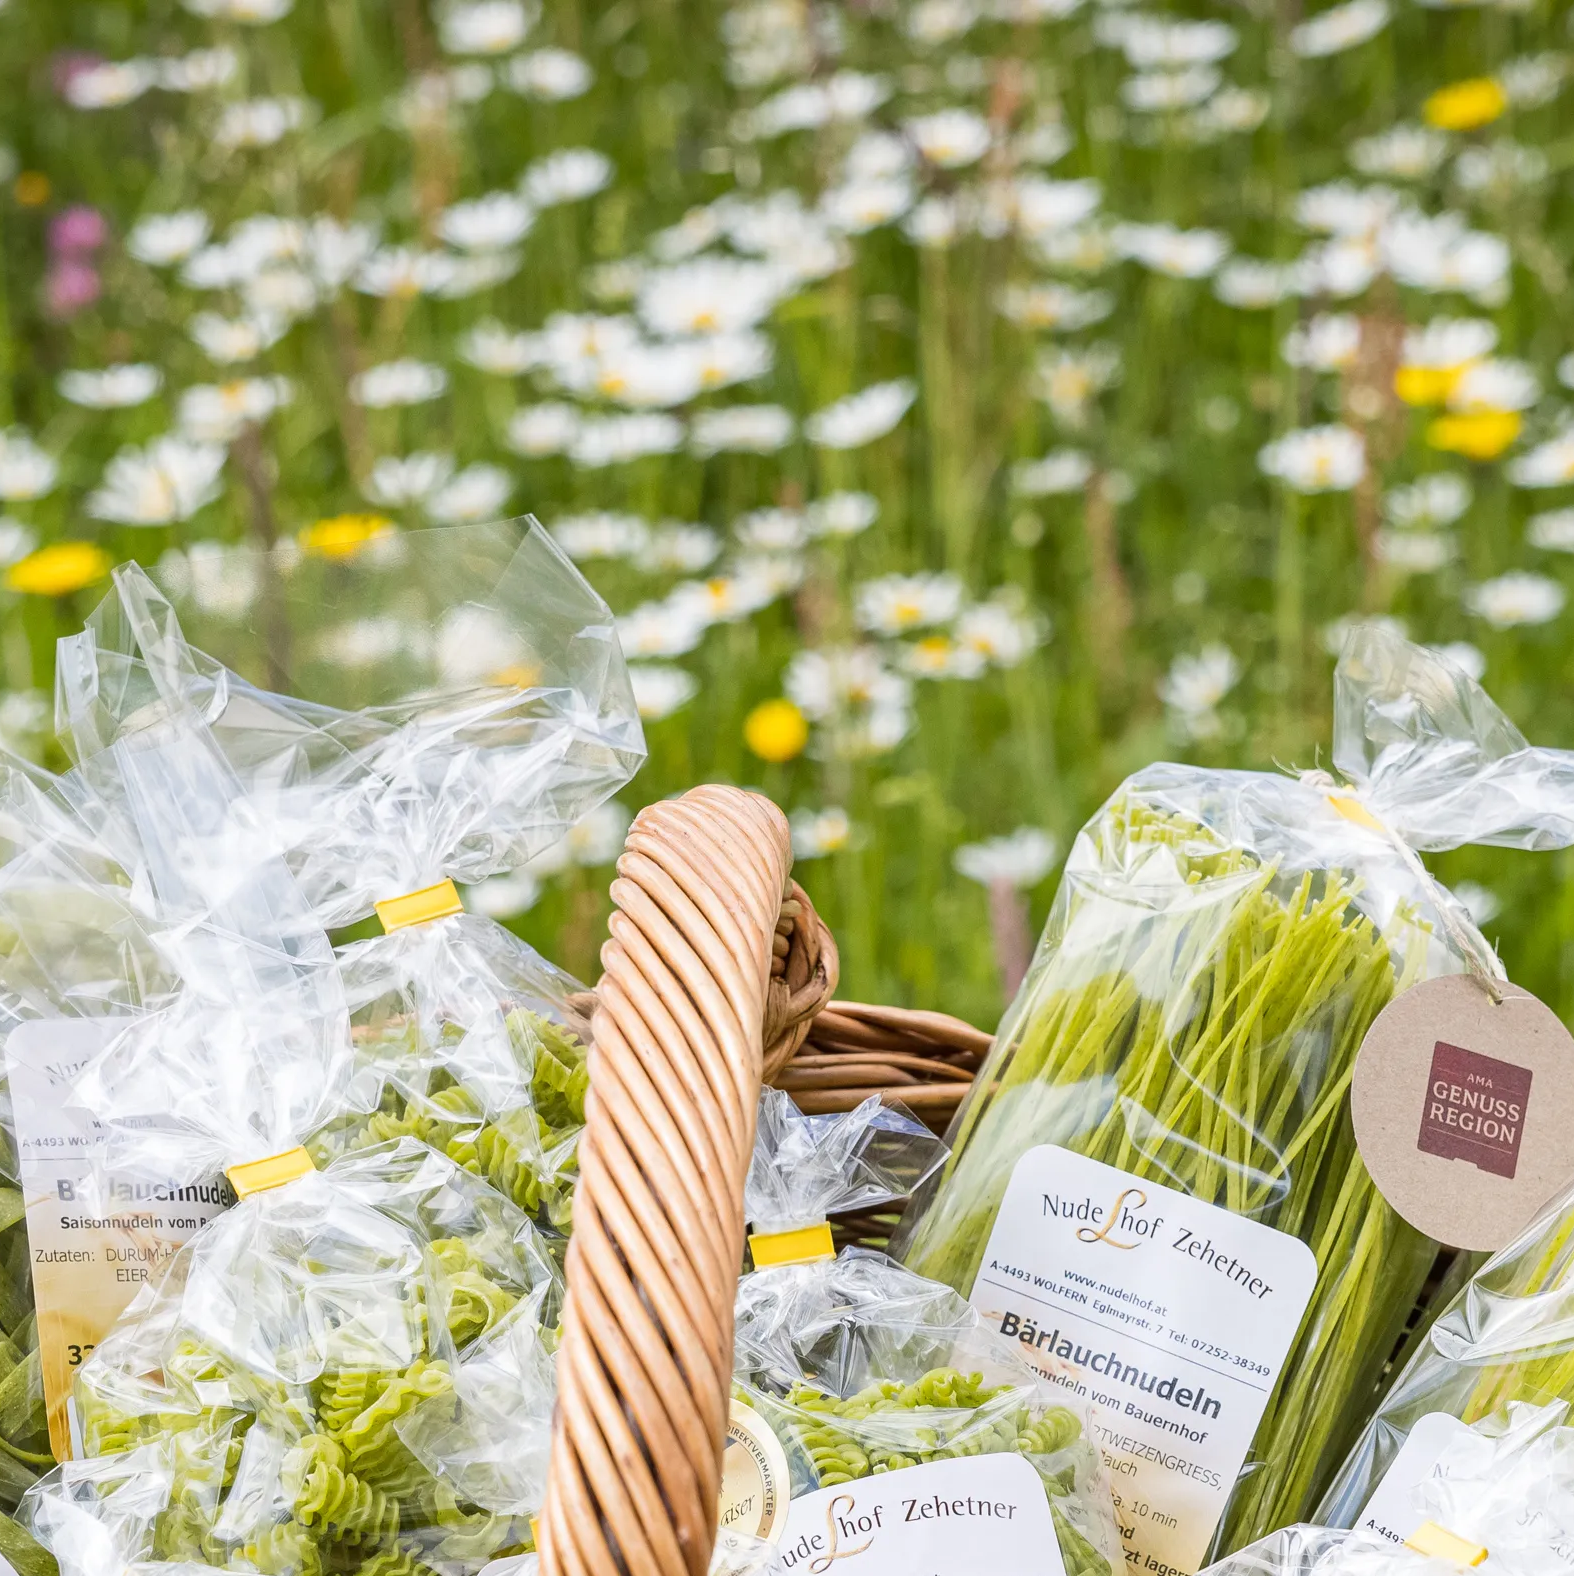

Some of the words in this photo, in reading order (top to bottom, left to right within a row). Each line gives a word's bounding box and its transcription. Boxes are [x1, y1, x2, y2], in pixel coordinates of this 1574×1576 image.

[1432, 1080, 1520, 1122] GENUSS
[1466, 1072, 1493, 1089] AMA
[1429, 1102, 1515, 1144] REGION
[60, 1216, 163, 1229] Saisonnudeln
[168, 1217, 196, 1229] vom
[35, 1249, 95, 1263] Zutaten:
[117, 1269, 154, 1282] EIER,
[1172, 1227, 1273, 1300] Zehetner
[1064, 1269, 1167, 1318] www.nudelhof.at
[990, 1260, 1030, 1282] A-4493
[1034, 1272, 1088, 1304] WOLFERN
[1093, 1300, 1152, 1330] Eglmayrstr.
[1156, 1324, 1163, 1334] 7
[1169, 1329, 1189, 1345] Tel:
[1191, 1338, 1271, 1377] 07252-38349
[999, 1311, 1223, 1420] Bärlauchnudeln
[1091, 1387, 1120, 1410] vom
[1124, 1402, 1209, 1446] Bauernhof
[902, 1495, 1017, 1523] Zehetner
[1131, 1500, 1149, 1517] 10
[1152, 1510, 1178, 1529] min
